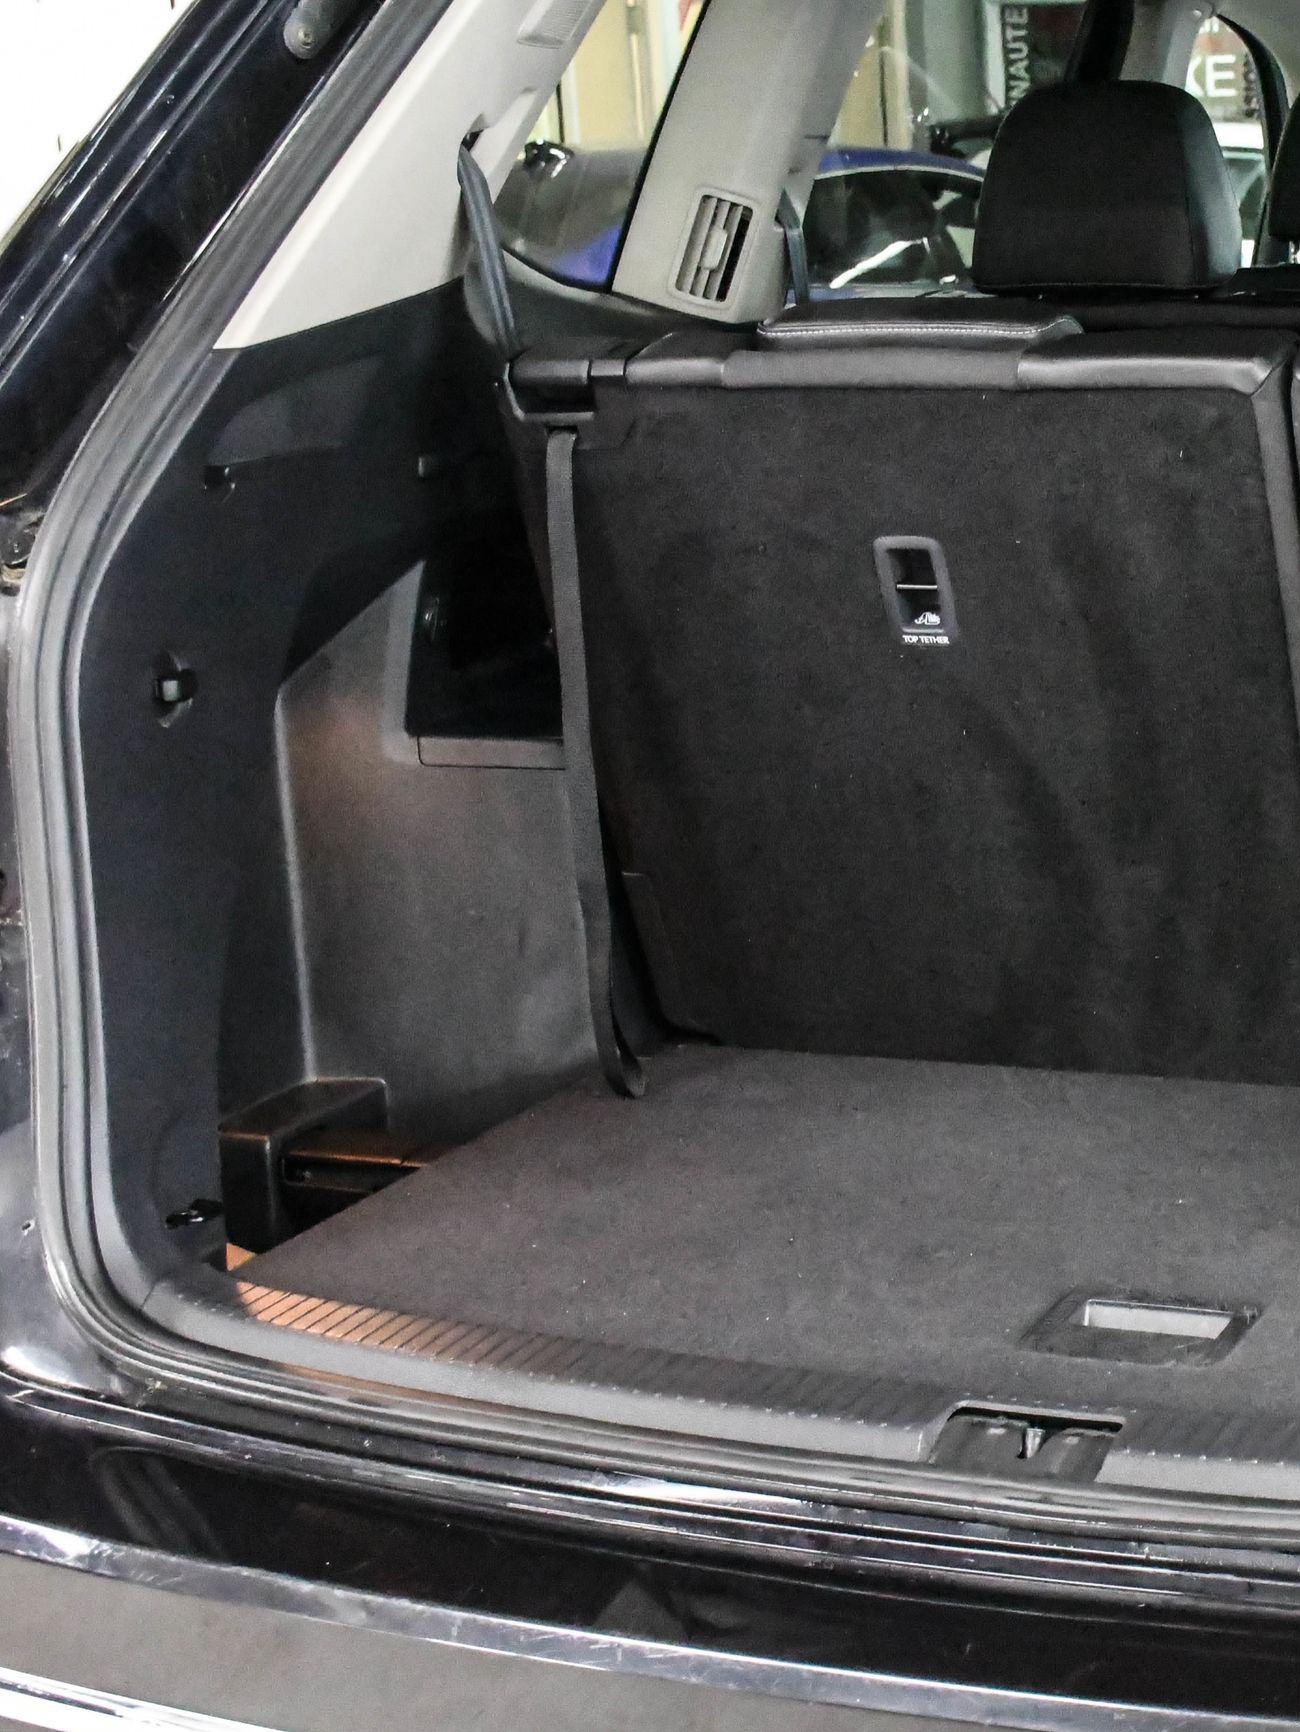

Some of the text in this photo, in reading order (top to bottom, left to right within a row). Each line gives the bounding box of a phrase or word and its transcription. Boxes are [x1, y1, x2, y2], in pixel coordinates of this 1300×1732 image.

[1005, 7, 1030, 105] NAUTE
[902, 635, 950, 644] TOP TETHER
